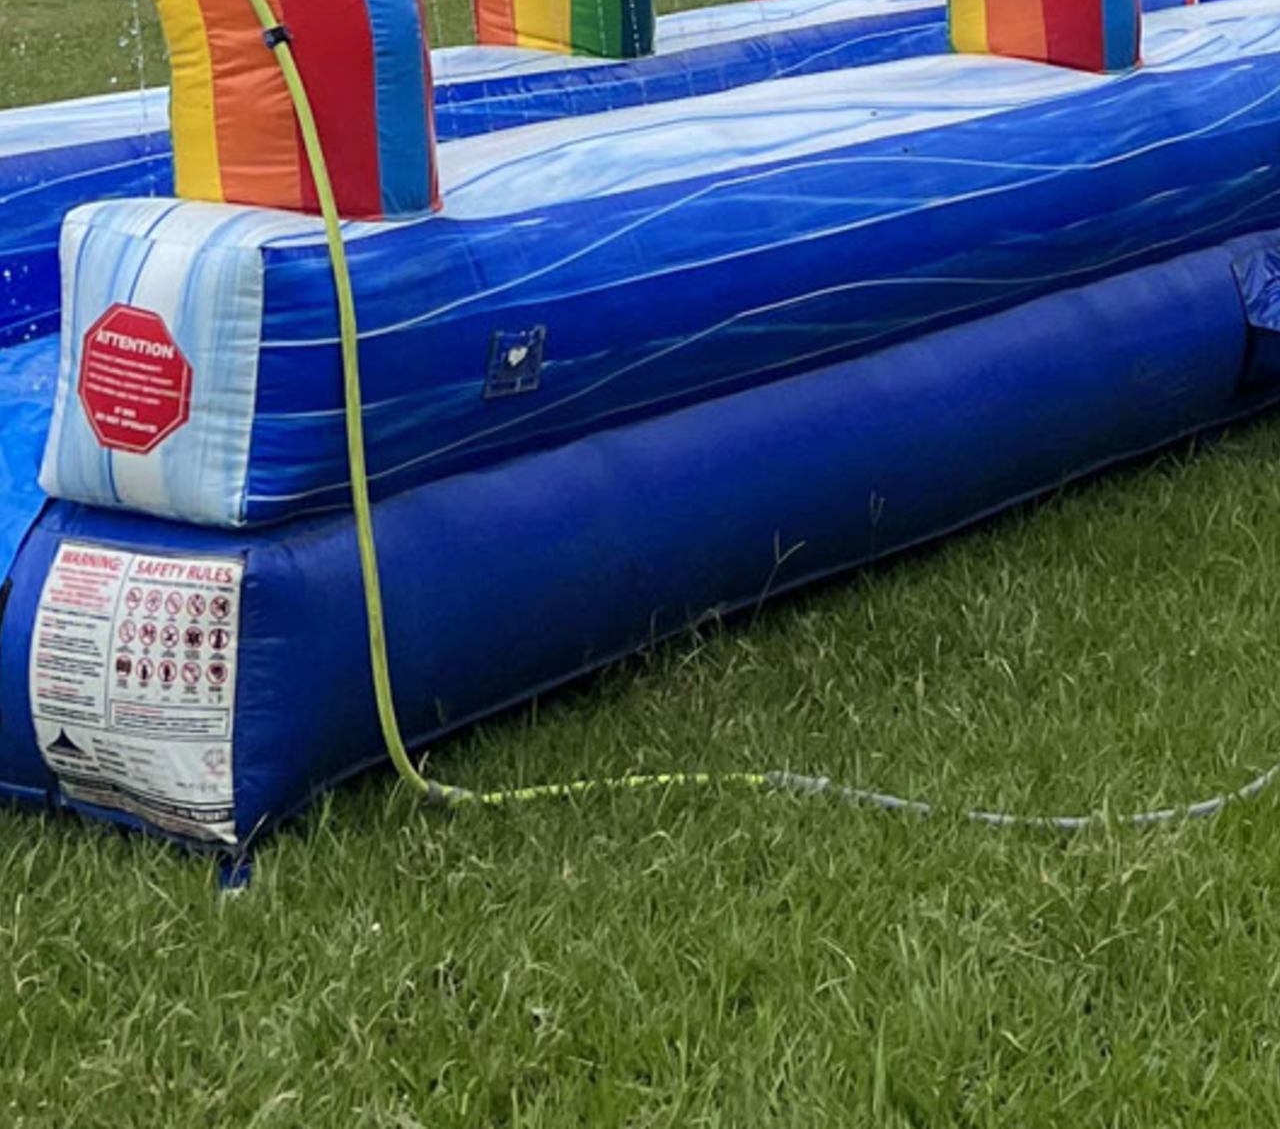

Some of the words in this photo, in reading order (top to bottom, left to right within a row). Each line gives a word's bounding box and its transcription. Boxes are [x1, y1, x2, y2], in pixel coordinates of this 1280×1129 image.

[95, 329, 174, 359] ATTENTION
[136, 560, 186, 578] SAFETY
[186, 565, 233, 584] RULES
